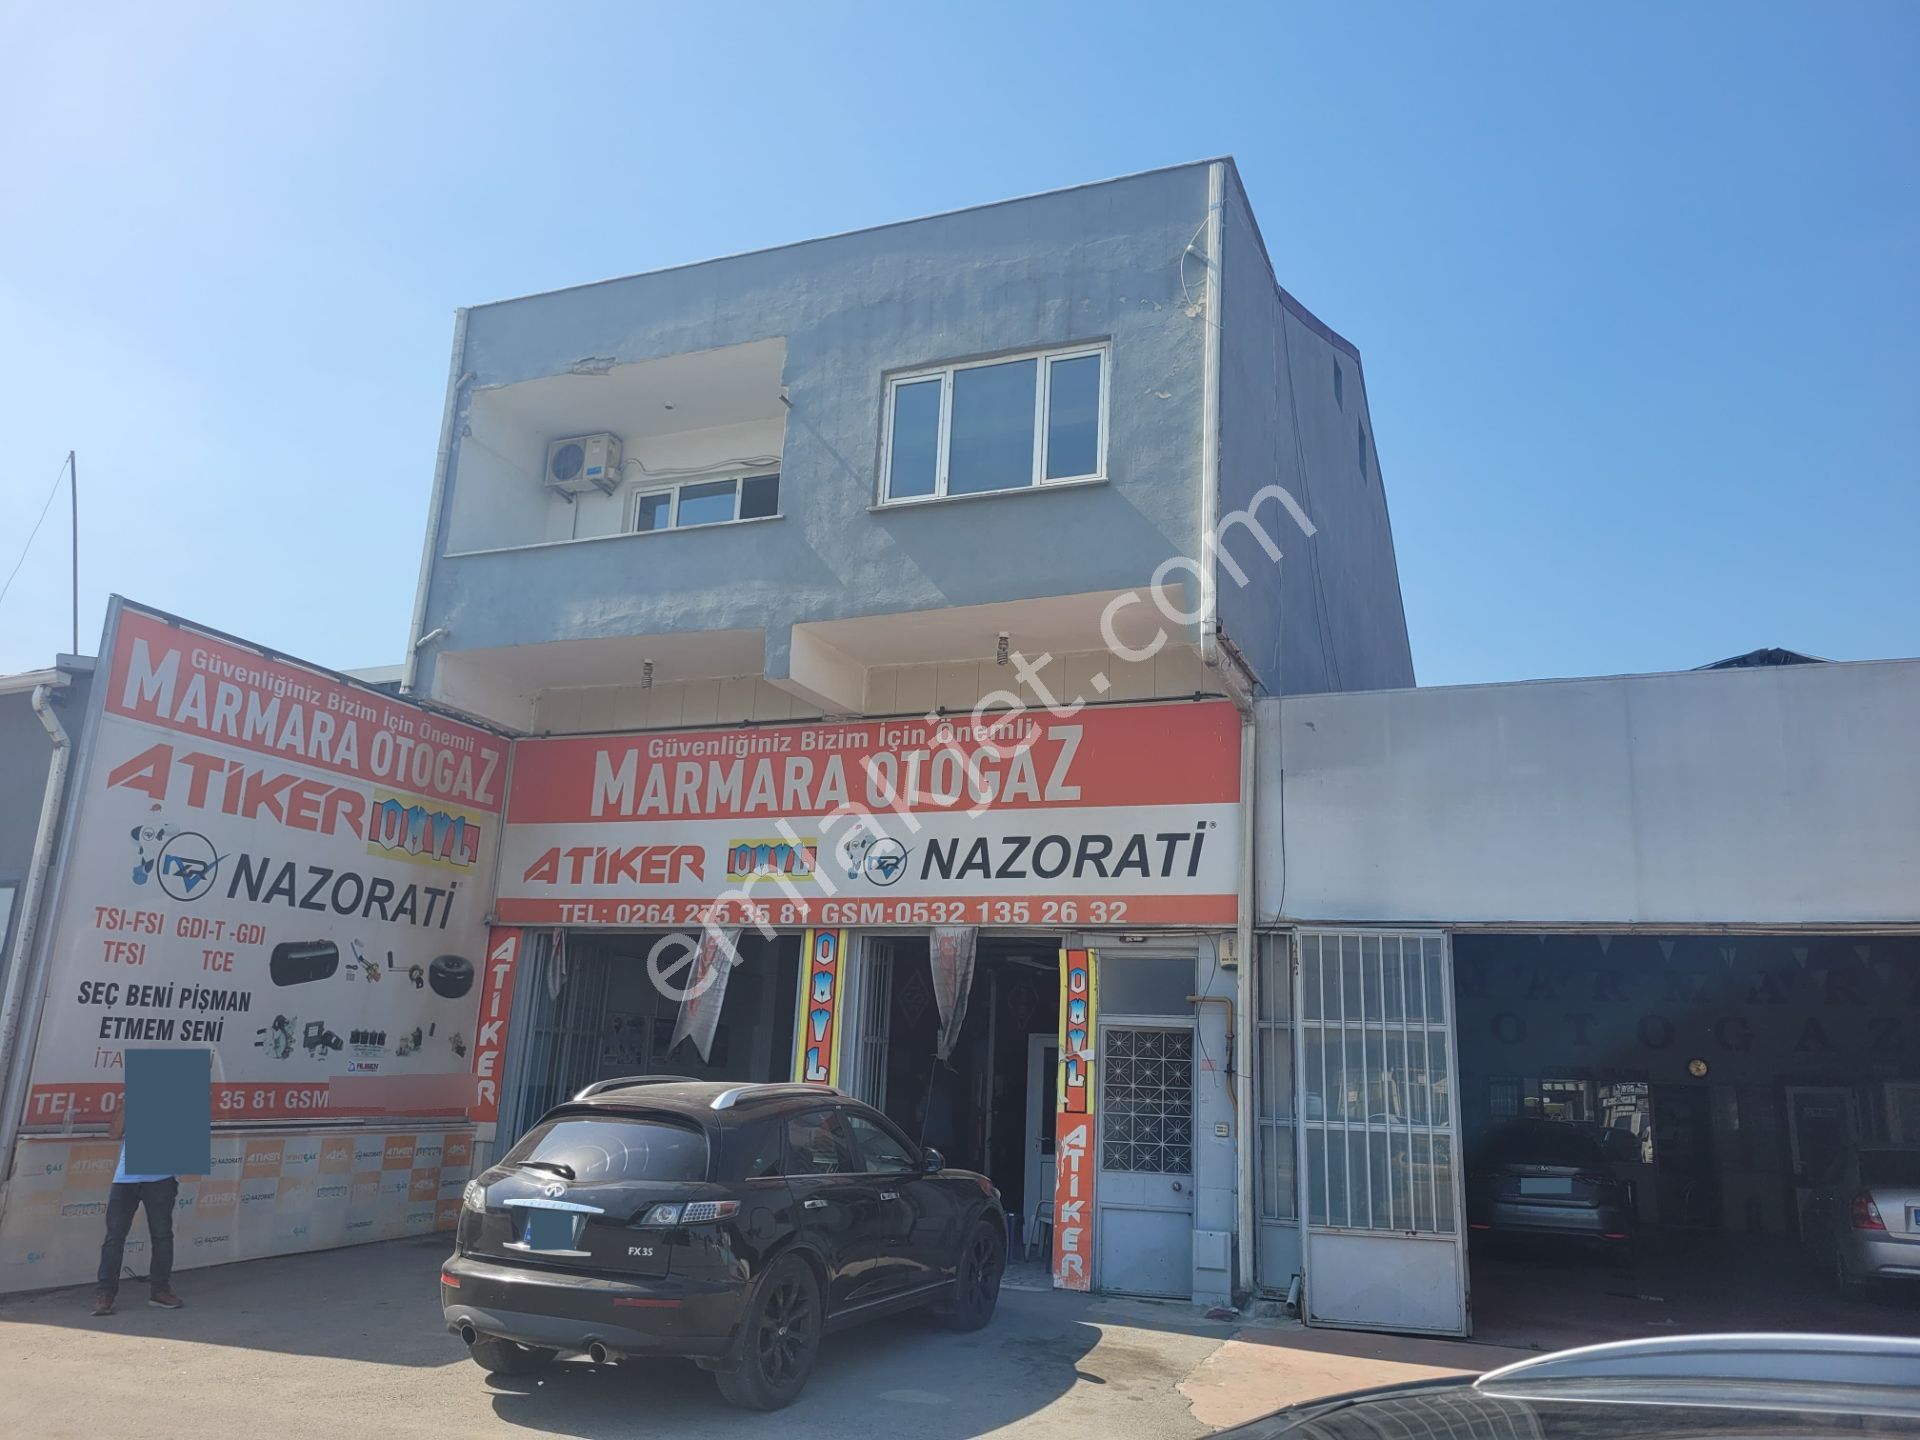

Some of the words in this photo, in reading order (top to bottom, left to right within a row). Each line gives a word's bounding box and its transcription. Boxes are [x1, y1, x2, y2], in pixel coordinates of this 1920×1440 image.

[190, 648, 321, 705] Güvenliğiniz
[327, 691, 377, 723] Bizim
[383, 706, 414, 735] İçin
[420, 718, 475, 753] Önemli
[121, 637, 360, 771] MARMARA
[370, 731, 500, 805] OTOGAZ
[648, 732, 792, 759] Güvenliğiniz
[800, 728, 869, 751] Bizim
[878, 723, 927, 751] İçin
[937, 717, 1033, 744] Önemli
[590, 748, 850, 817] MARMARA
[865, 724, 1084, 808] OTOGAZ
[107, 743, 367, 841] ATİKER
[522, 845, 706, 885] ATİKER
[226, 853, 458, 930] NAZORATİ
[95, 906, 164, 935] TSI-FSI
[558, 903, 608, 924] TEL:
[616, 903, 676, 924] 0264
[684, 903, 731, 924] 275
[740, 903, 770, 924] 35
[780, 903, 809, 924] 81
[975, 901, 1031, 925] 135
[1041, 901, 1078, 925] 26
[1089, 901, 1128, 924] 32
[103, 940, 146, 965] TFSI
[202, 949, 235, 973] TCE
[77, 980, 120, 1010] SEÇ
[125, 981, 174, 1009] BENİ
[179, 983, 252, 1014] PİŞMAN
[98, 1016, 175, 1042] ETMEM
[180, 1016, 224, 1042] SENİ
[477, 936, 517, 1106] ATİKER
[33, 1092, 91, 1115] TEL:
[219, 1090, 245, 1110] 35
[252, 1090, 276, 1109] 81
[283, 1090, 330, 1109] GSM
